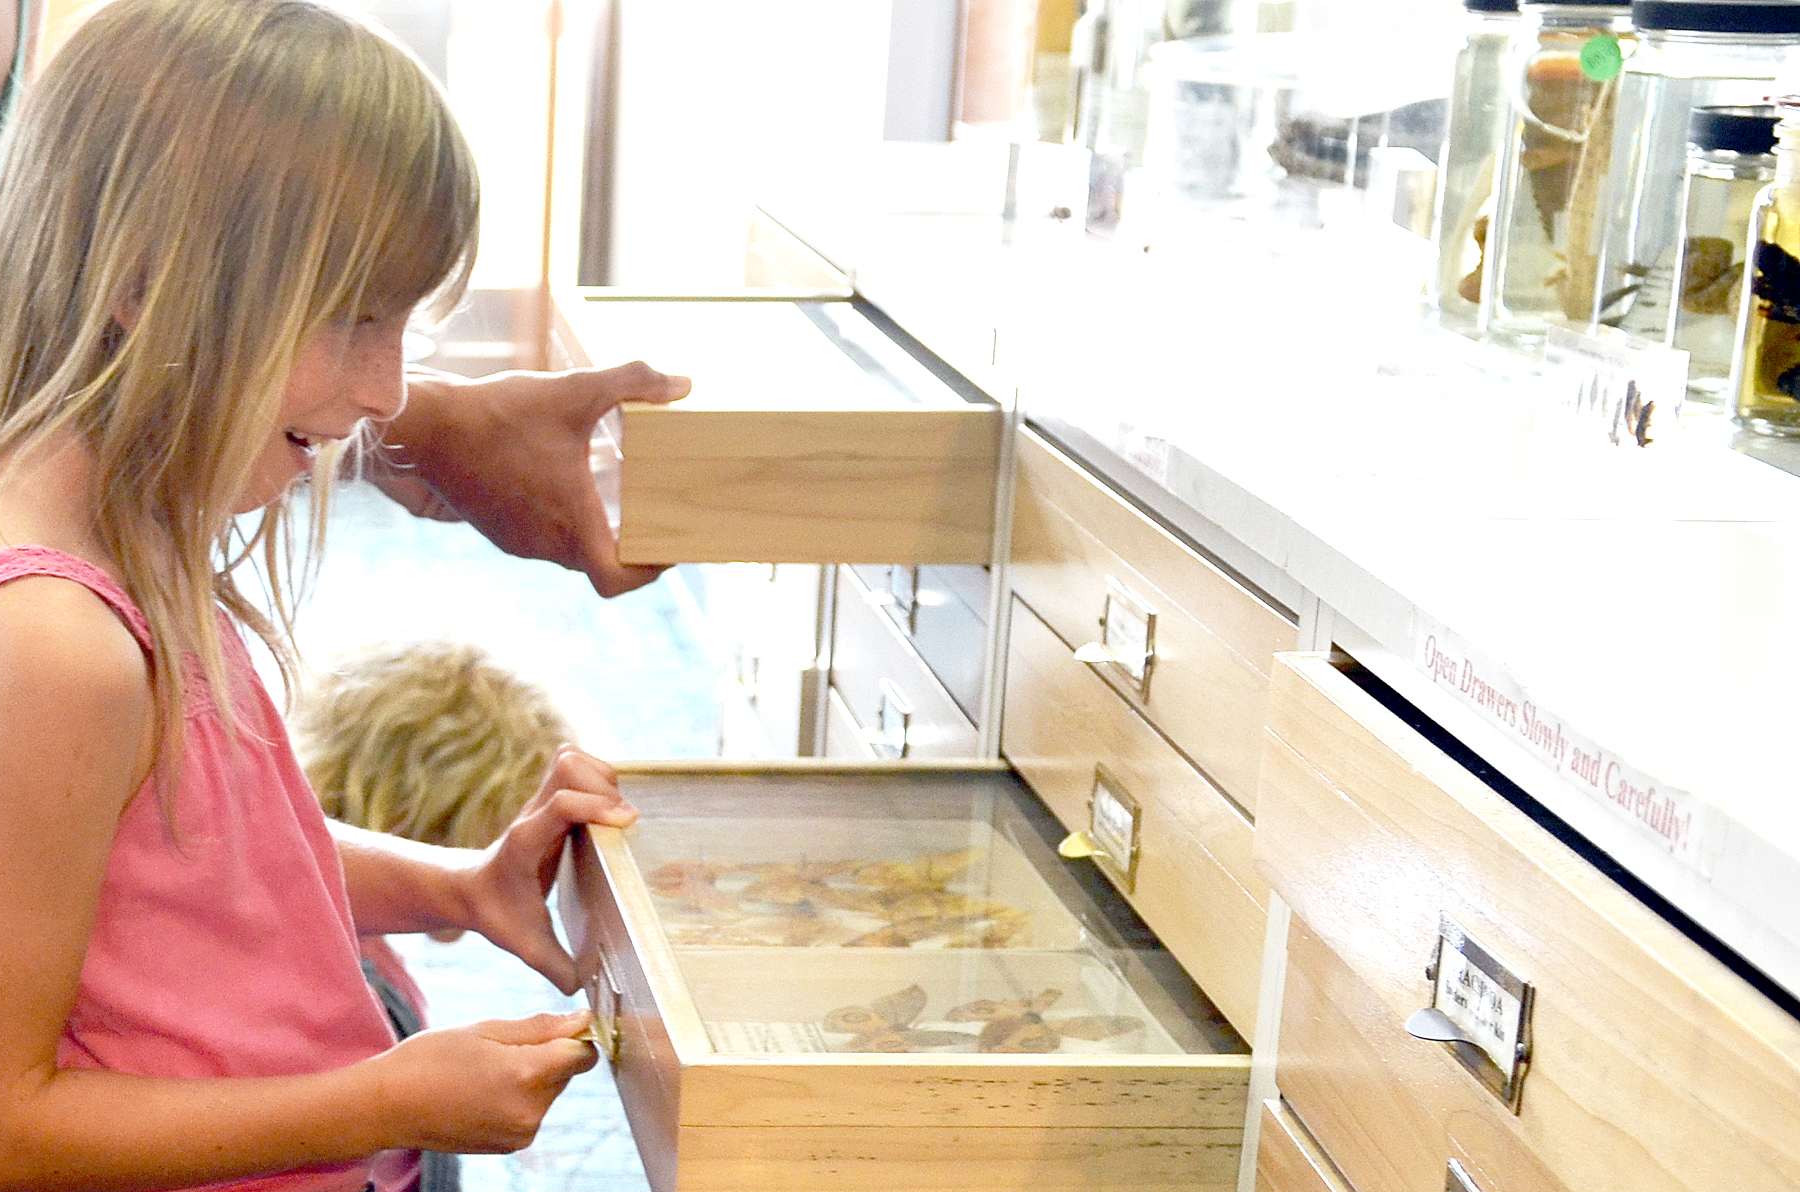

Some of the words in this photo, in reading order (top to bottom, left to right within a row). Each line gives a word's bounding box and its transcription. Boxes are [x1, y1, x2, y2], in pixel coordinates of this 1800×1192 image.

[1424, 635, 1458, 687] Open
[1460, 658, 1519, 728] Drawers
[1520, 699, 1569, 773] Slowly
[1570, 746, 1603, 788] and
[1604, 760, 1693, 853] Carefully!
